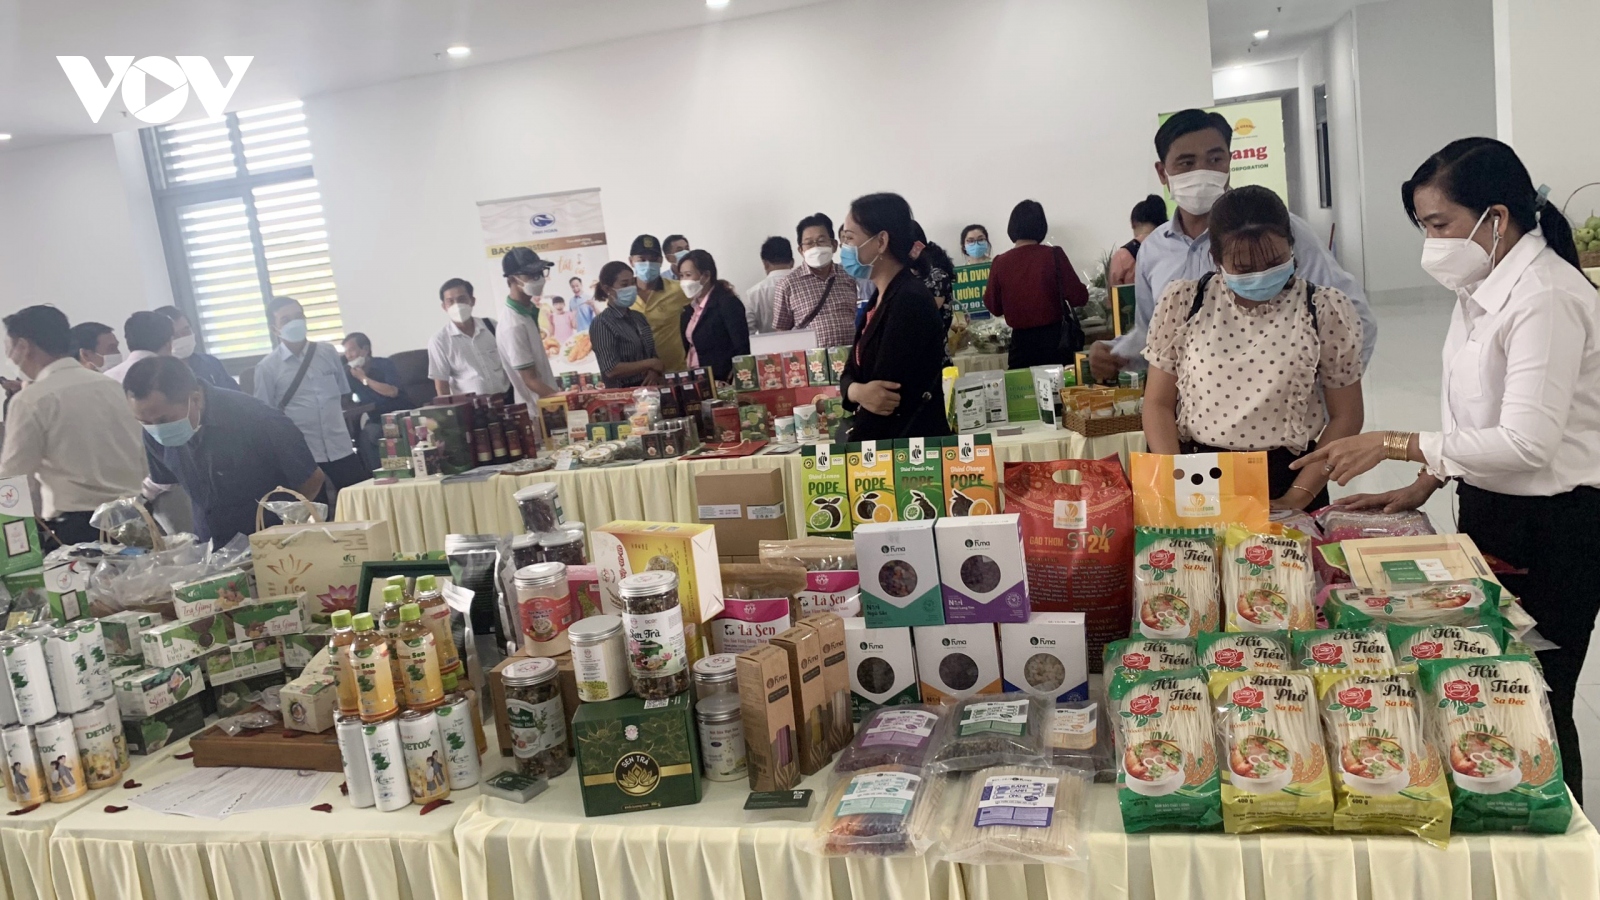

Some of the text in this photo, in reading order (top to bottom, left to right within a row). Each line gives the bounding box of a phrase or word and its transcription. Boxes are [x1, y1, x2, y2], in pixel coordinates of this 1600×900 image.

[854, 477, 887, 493] POPE
[901, 475, 935, 489] POPE
[949, 473, 985, 489] POPE
[808, 481, 840, 496] POPE
[1183, 563, 1195, 571] Sa
[828, 594, 846, 606] Sen
[738, 623, 776, 638] Lá Sen
[1432, 628, 1462, 639] Hủ
[1352, 639, 1387, 654] Tiếu
[1453, 639, 1489, 655] Tiếu
[1253, 647, 1286, 661] Tiếu
[1468, 664, 1500, 678] Hủ
[1250, 675, 1293, 687] Bánh
[1490, 678, 1531, 695] Tiếu
[1169, 686, 1203, 701] Tiếu
[1273, 688, 1308, 702] Phở
[1382, 684, 1417, 699] Phở
[1493, 697, 1507, 705] Sa
[621, 756, 635, 768] SEN
